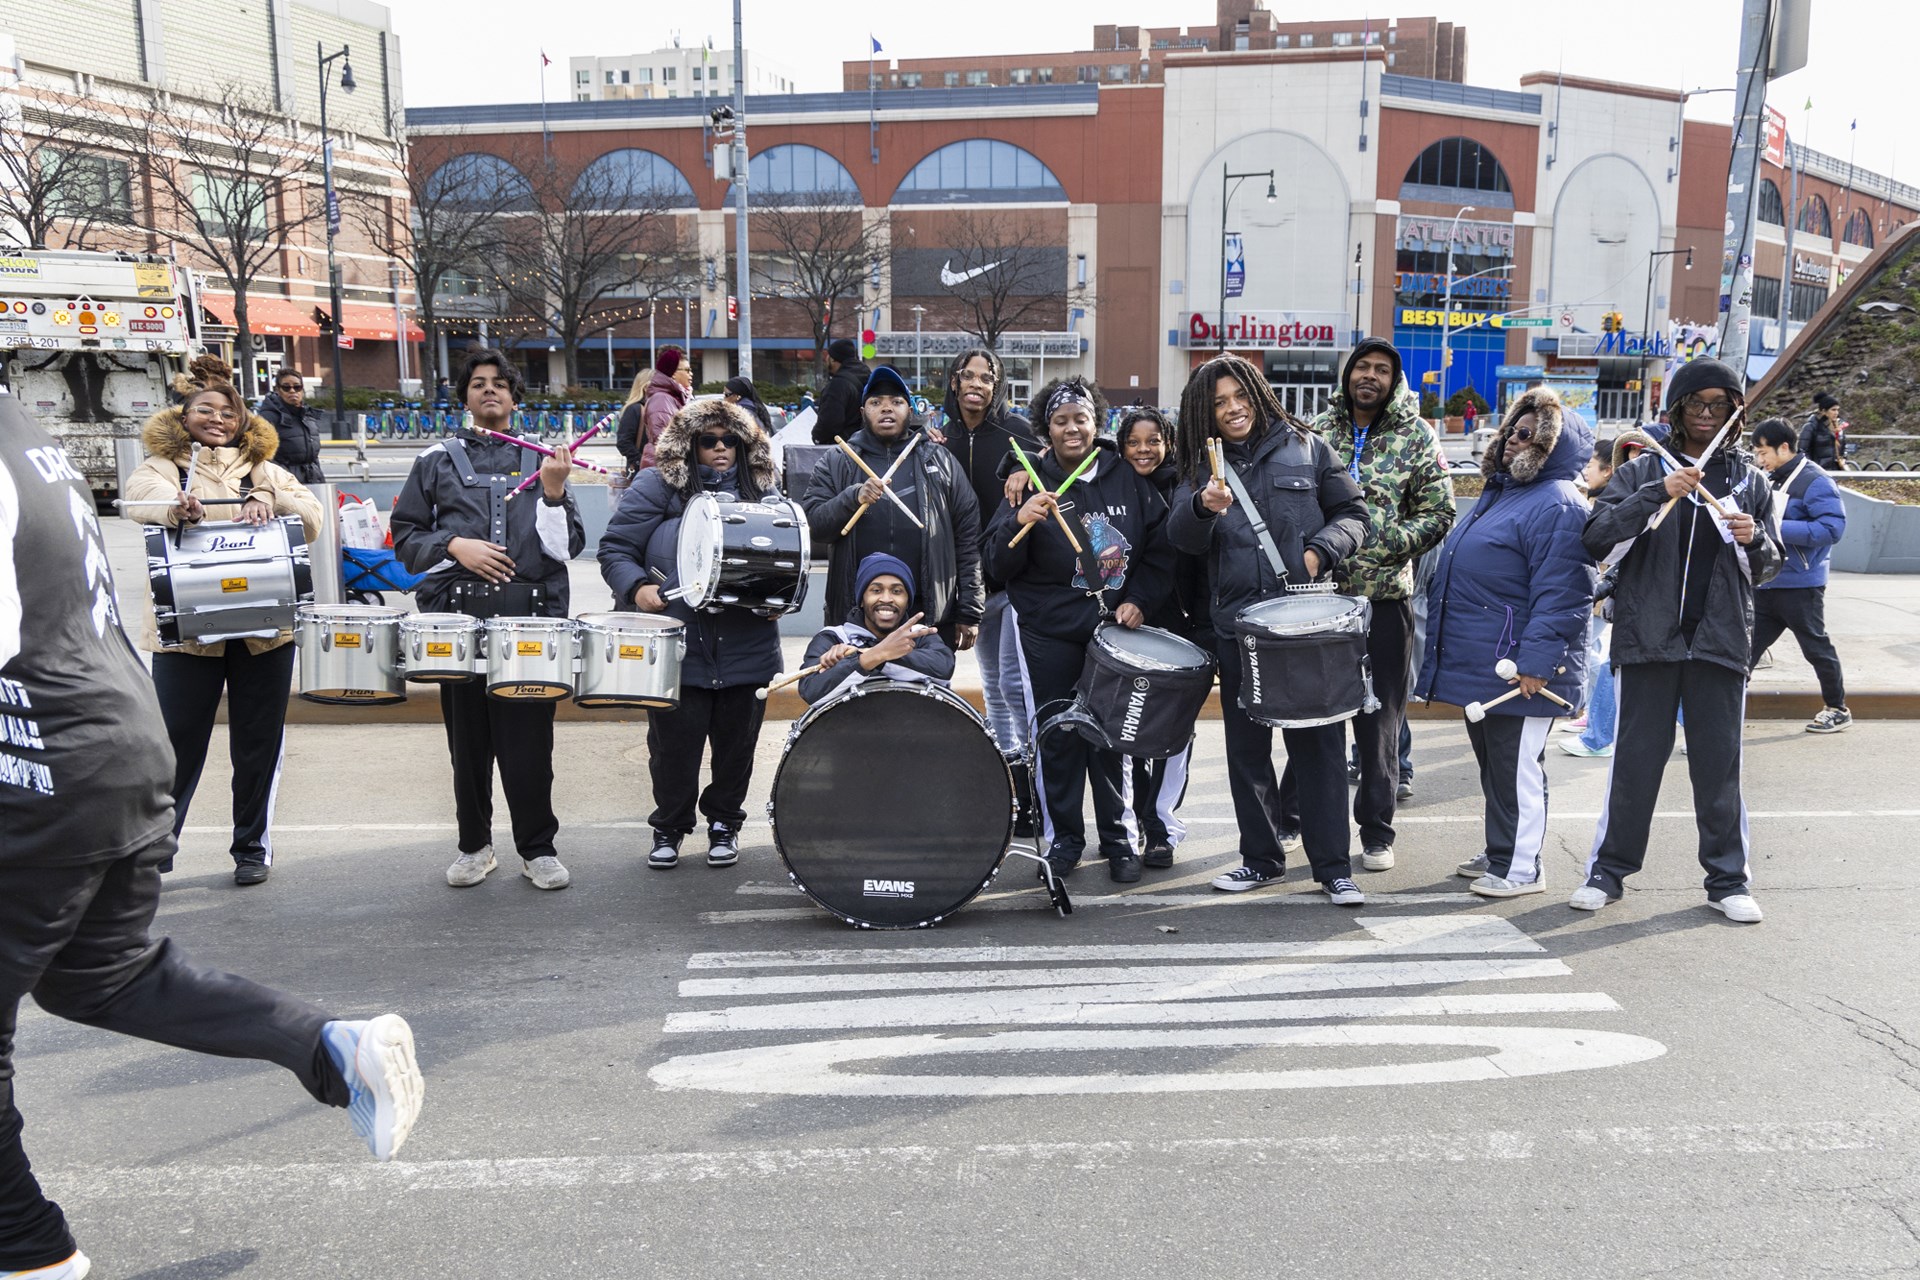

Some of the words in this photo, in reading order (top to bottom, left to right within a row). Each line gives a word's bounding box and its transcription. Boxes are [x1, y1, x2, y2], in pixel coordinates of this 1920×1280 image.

[1403, 220, 1512, 246] ATLANTIC
[1401, 272, 1434, 293] DAVE
[1437, 275, 1448, 294] &
[131, 322, 164, 331] HE-5000
[1402, 309, 1445, 327] BEST
[1449, 311, 1487, 328] BUY
[1190, 312, 1335, 349] Burlington
[165, 340, 174, 351] 2
[1593, 328, 1671, 356] Marsha
[735, 502, 778, 515] Pearl
[202, 535, 256, 553] Pearl
[1247, 651, 1263, 705] YAMAHA
[1120, 691, 1147, 742] YAMAHA
[863, 879, 915, 893] EVANS
